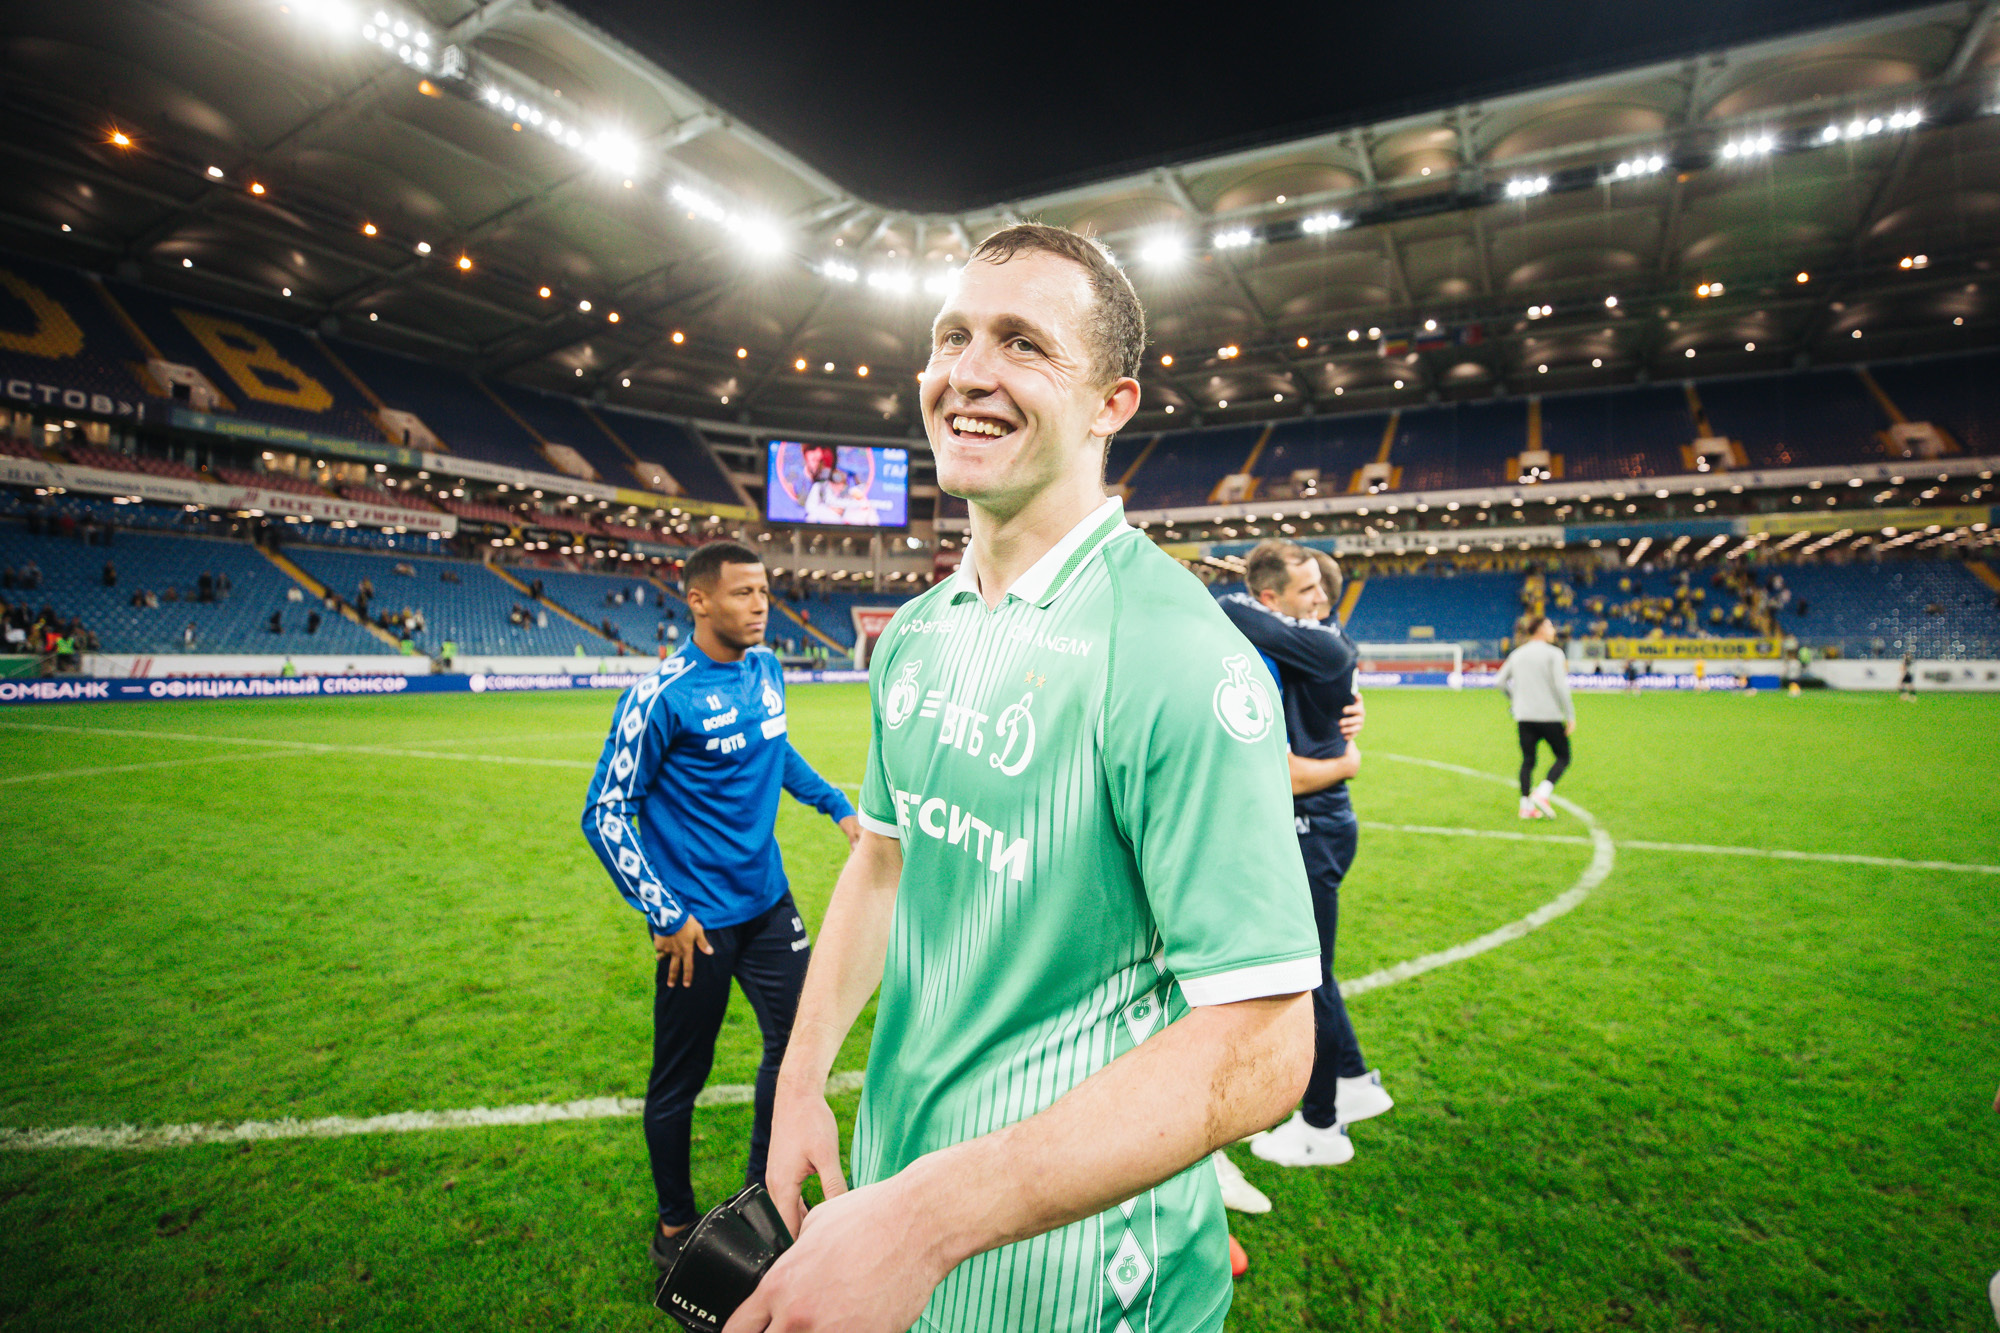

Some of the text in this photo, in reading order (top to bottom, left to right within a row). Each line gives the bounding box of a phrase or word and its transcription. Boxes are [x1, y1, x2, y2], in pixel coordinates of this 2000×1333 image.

[150, 676, 320, 698] ОФИЦИАЛЬНЫЙ
[323, 677, 408, 694] СПОНСОР
[938, 702, 989, 757] ВТБ
[672, 1293, 717, 1324] ULTRA
